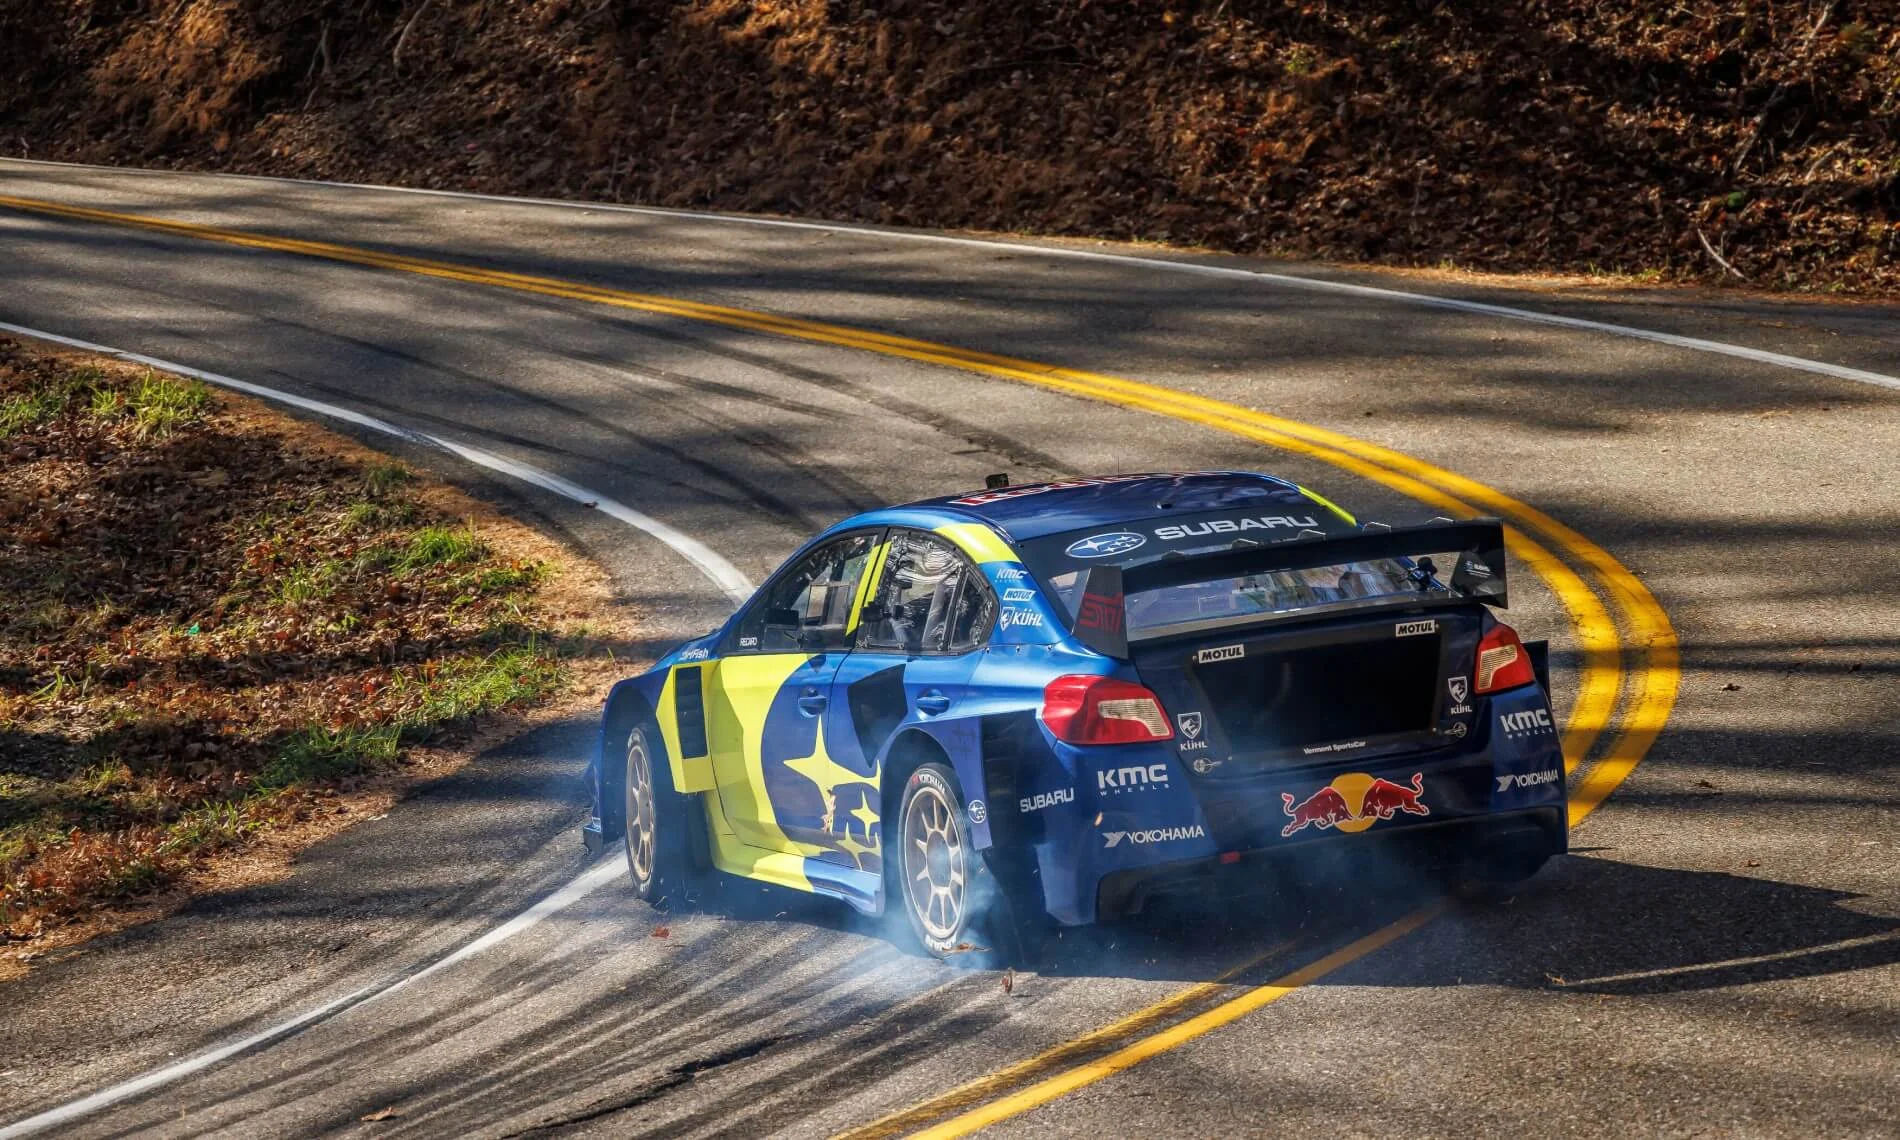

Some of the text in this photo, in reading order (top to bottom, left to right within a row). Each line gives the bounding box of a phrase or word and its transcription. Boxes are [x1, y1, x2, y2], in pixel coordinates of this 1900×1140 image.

[1154, 515, 1320, 541] SUBARU
[995, 568, 1029, 579] KMC
[1011, 607, 1043, 627] KÜHL
[1397, 621, 1434, 635] MOTUL
[1200, 645, 1243, 661] MOTUL
[1450, 703, 1473, 715] KÜHL
[1499, 708, 1551, 733] KMC
[1180, 740, 1208, 752] KÜHL
[1303, 740, 1367, 755] Vermont SportsCar
[1097, 764, 1169, 790] KMC
[1514, 768, 1559, 788] YOKOHAMA
[1100, 783, 1170, 797] WHEELS
[1019, 787, 1075, 813] SUBARU
[1126, 825, 1206, 845] YOKOHAMA
